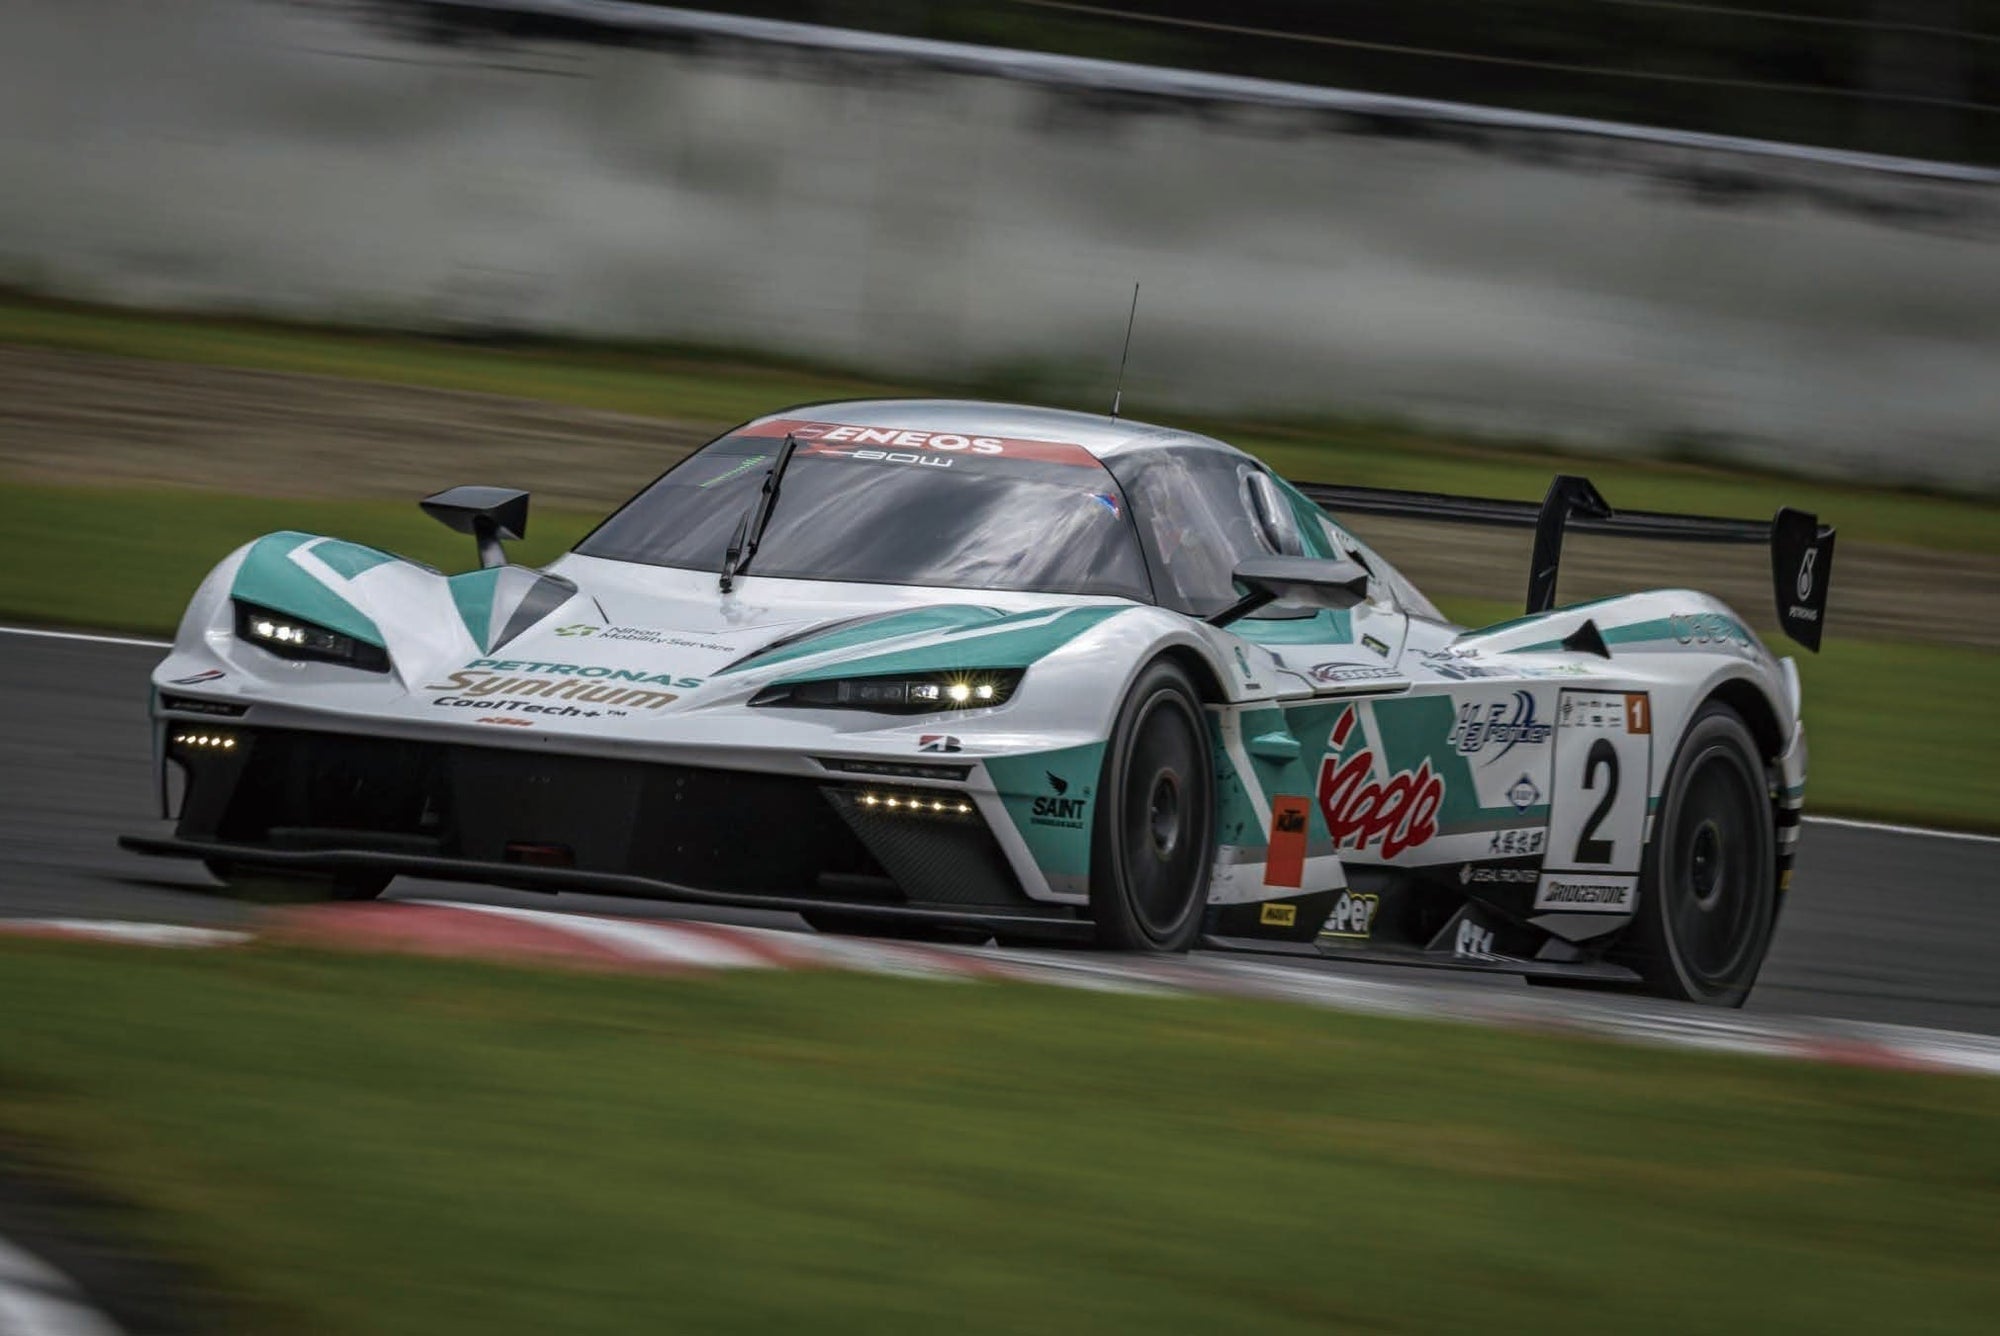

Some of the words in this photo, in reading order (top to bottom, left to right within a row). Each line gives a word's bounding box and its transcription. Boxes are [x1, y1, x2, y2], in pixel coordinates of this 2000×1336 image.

[822, 426, 1004, 455] ENEOS
[599, 632, 668, 646] Mobility
[668, 637, 736, 651] Service
[607, 626, 662, 636] Nihon
[463, 658, 705, 689] PETRONAS
[425, 671, 679, 710] Syntium
[1632, 700, 1644, 729] 1
[1032, 796, 1087, 820] SAINT
[1572, 737, 1621, 865] 2
[1544, 881, 1629, 904] BRIDGESTONE
